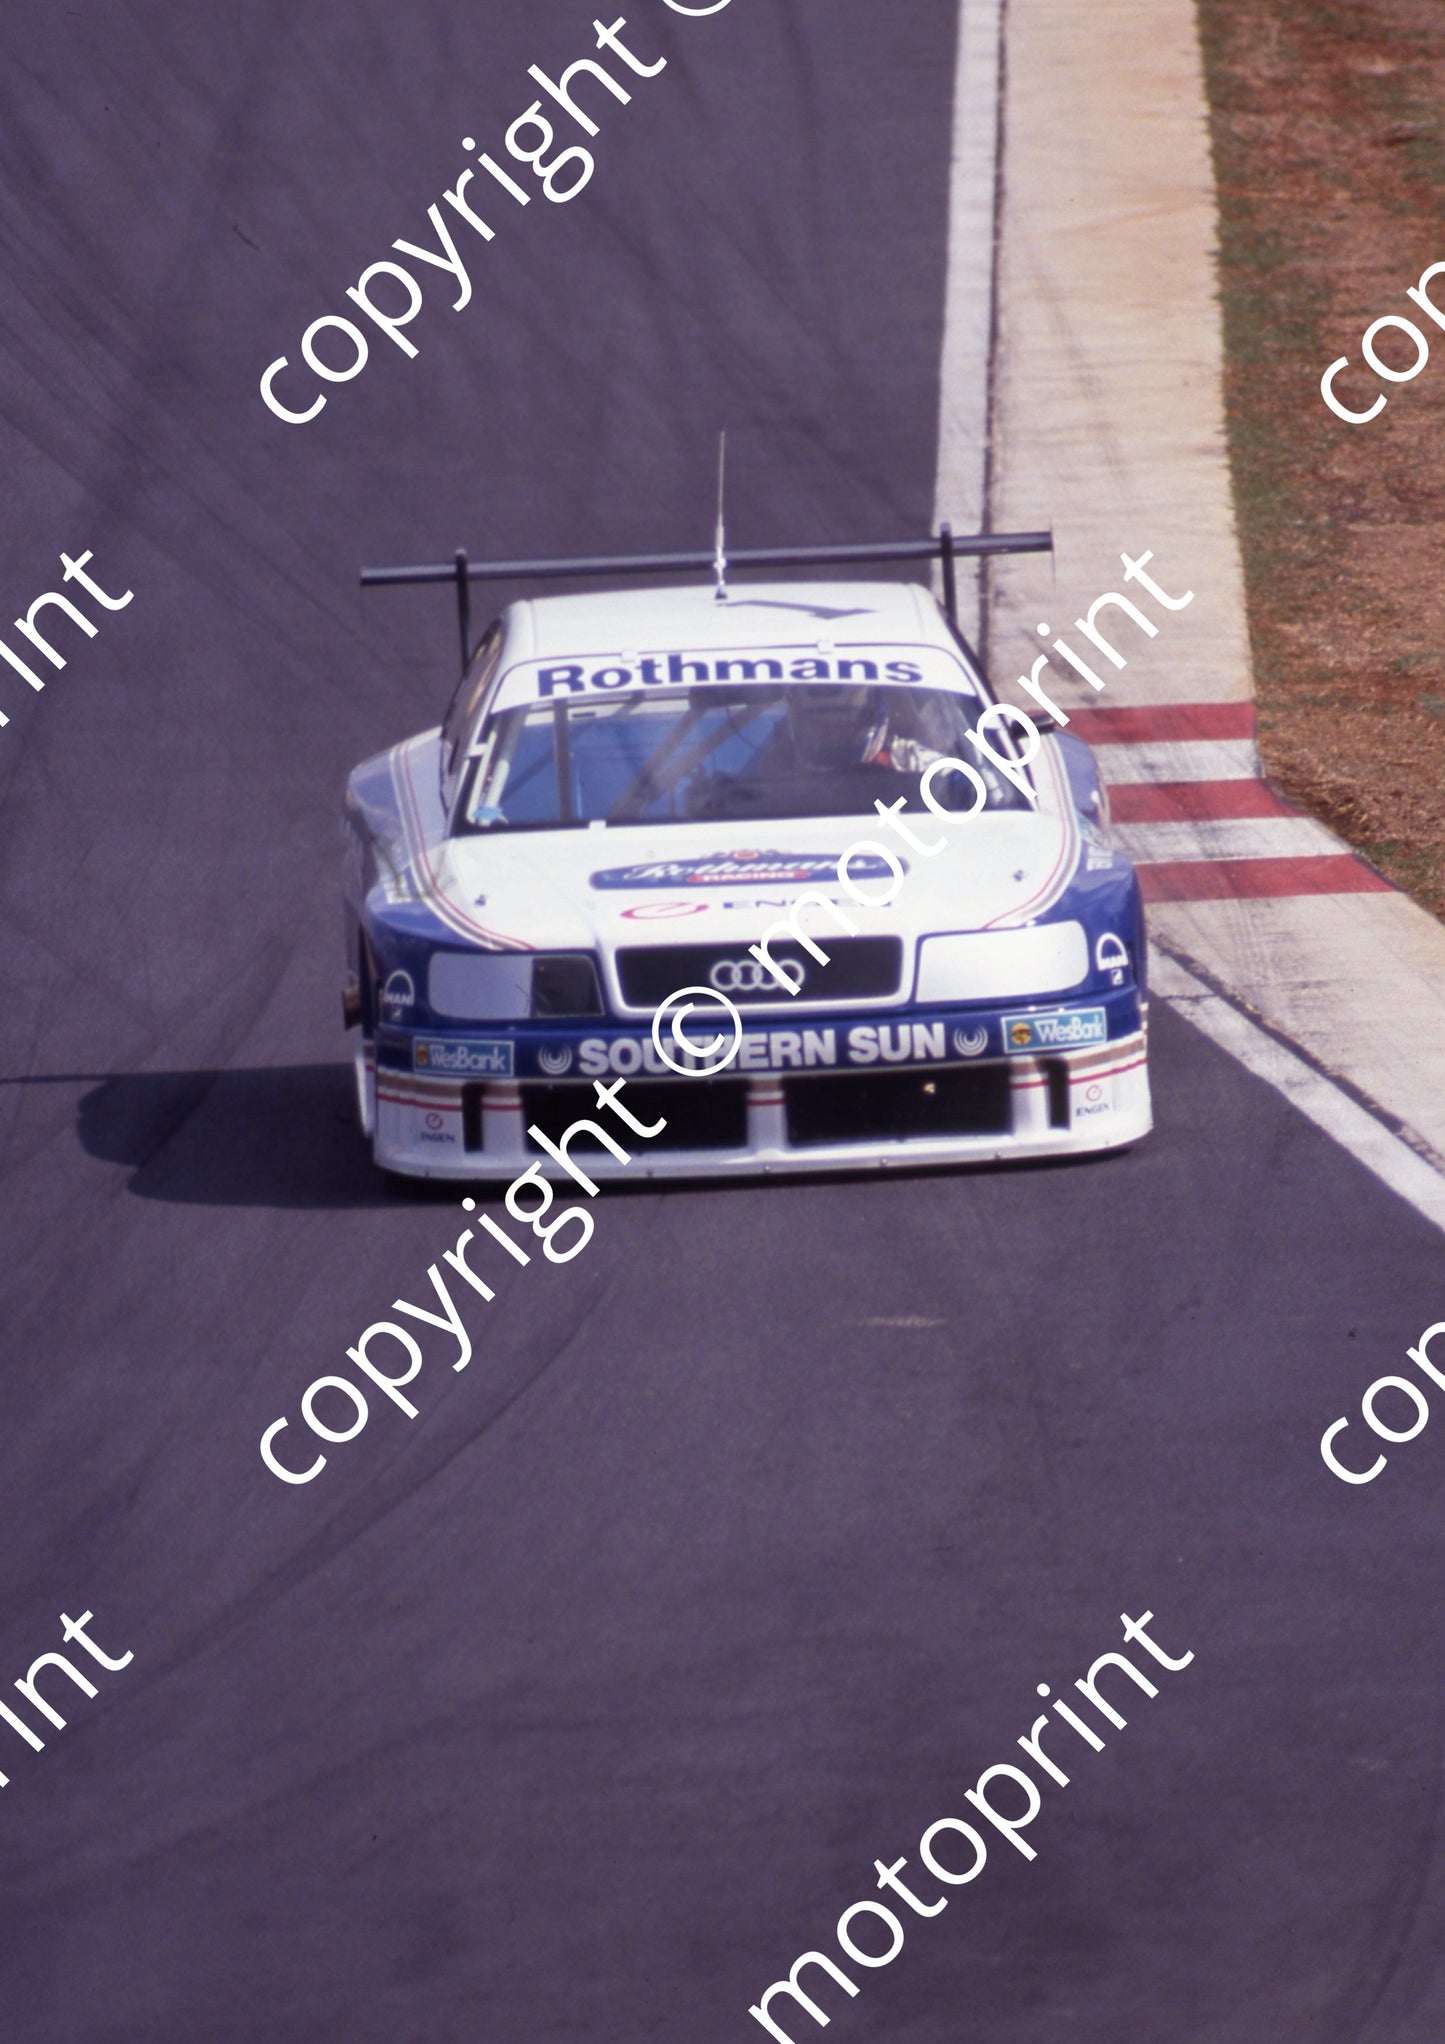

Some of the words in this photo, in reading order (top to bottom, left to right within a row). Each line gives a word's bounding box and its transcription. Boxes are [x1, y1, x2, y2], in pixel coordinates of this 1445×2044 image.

[538, 654, 923, 697] Rothmans
[1034, 1013, 1104, 1044] WesBank
[429, 1044, 506, 1071] WesBank
[578, 1029, 836, 1076] SOUTHERN
[847, 1022, 945, 1063] SUN
